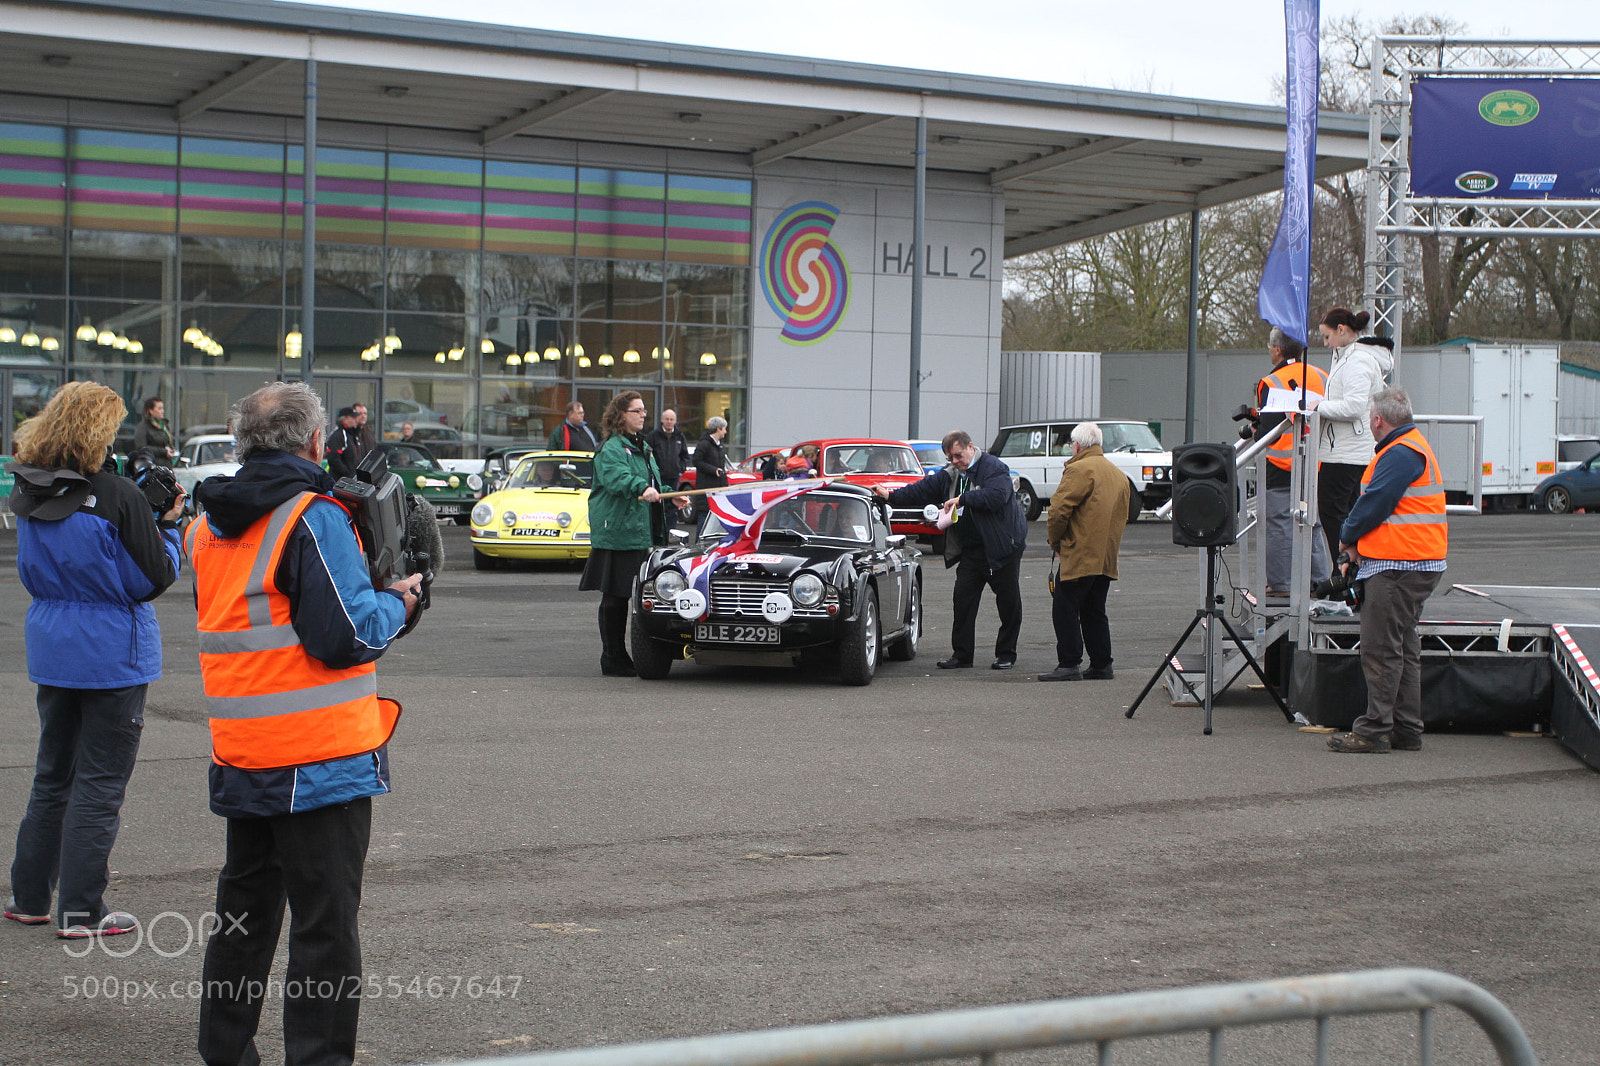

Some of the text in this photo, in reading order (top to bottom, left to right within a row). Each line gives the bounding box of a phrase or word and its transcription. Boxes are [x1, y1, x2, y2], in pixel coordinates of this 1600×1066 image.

[1516, 174, 1556, 183] MOTORS
[882, 241, 987, 279] HALL 2
[1030, 431, 1042, 450] 19
[533, 529, 558, 537] 274C
[697, 625, 779, 642] BLE 229B
